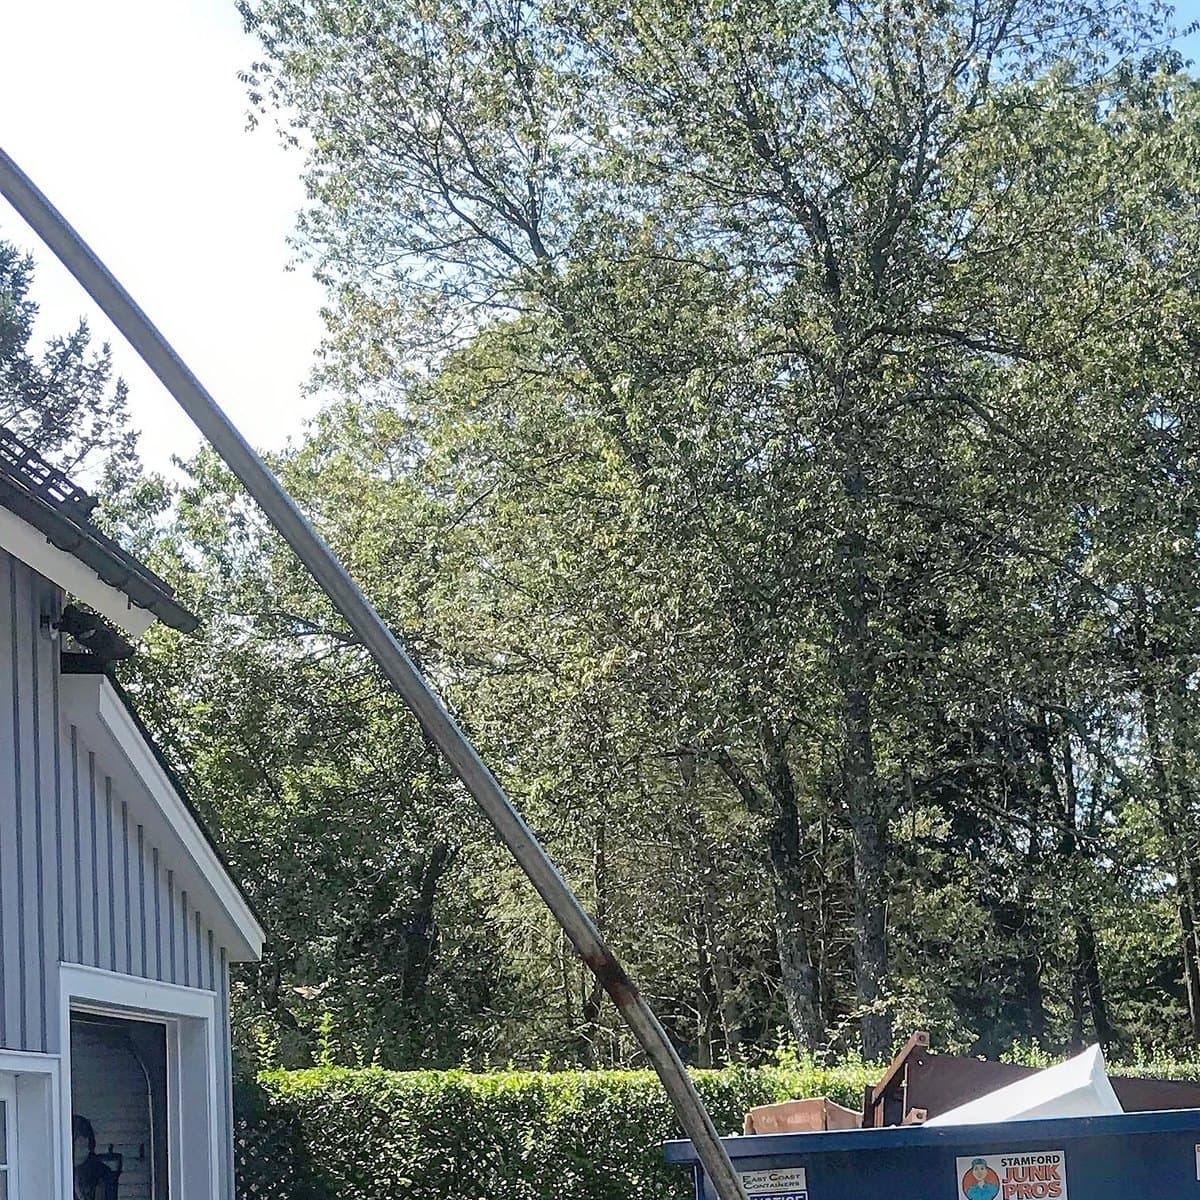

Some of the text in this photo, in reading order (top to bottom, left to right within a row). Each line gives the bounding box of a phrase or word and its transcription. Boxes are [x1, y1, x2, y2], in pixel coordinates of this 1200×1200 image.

[1001, 1155, 1060, 1167] STAMFORD
[743, 1173, 801, 1183] EAST COAST
[1002, 1165, 1061, 1183] JUNK
[1002, 1181, 1063, 1200] PROS
